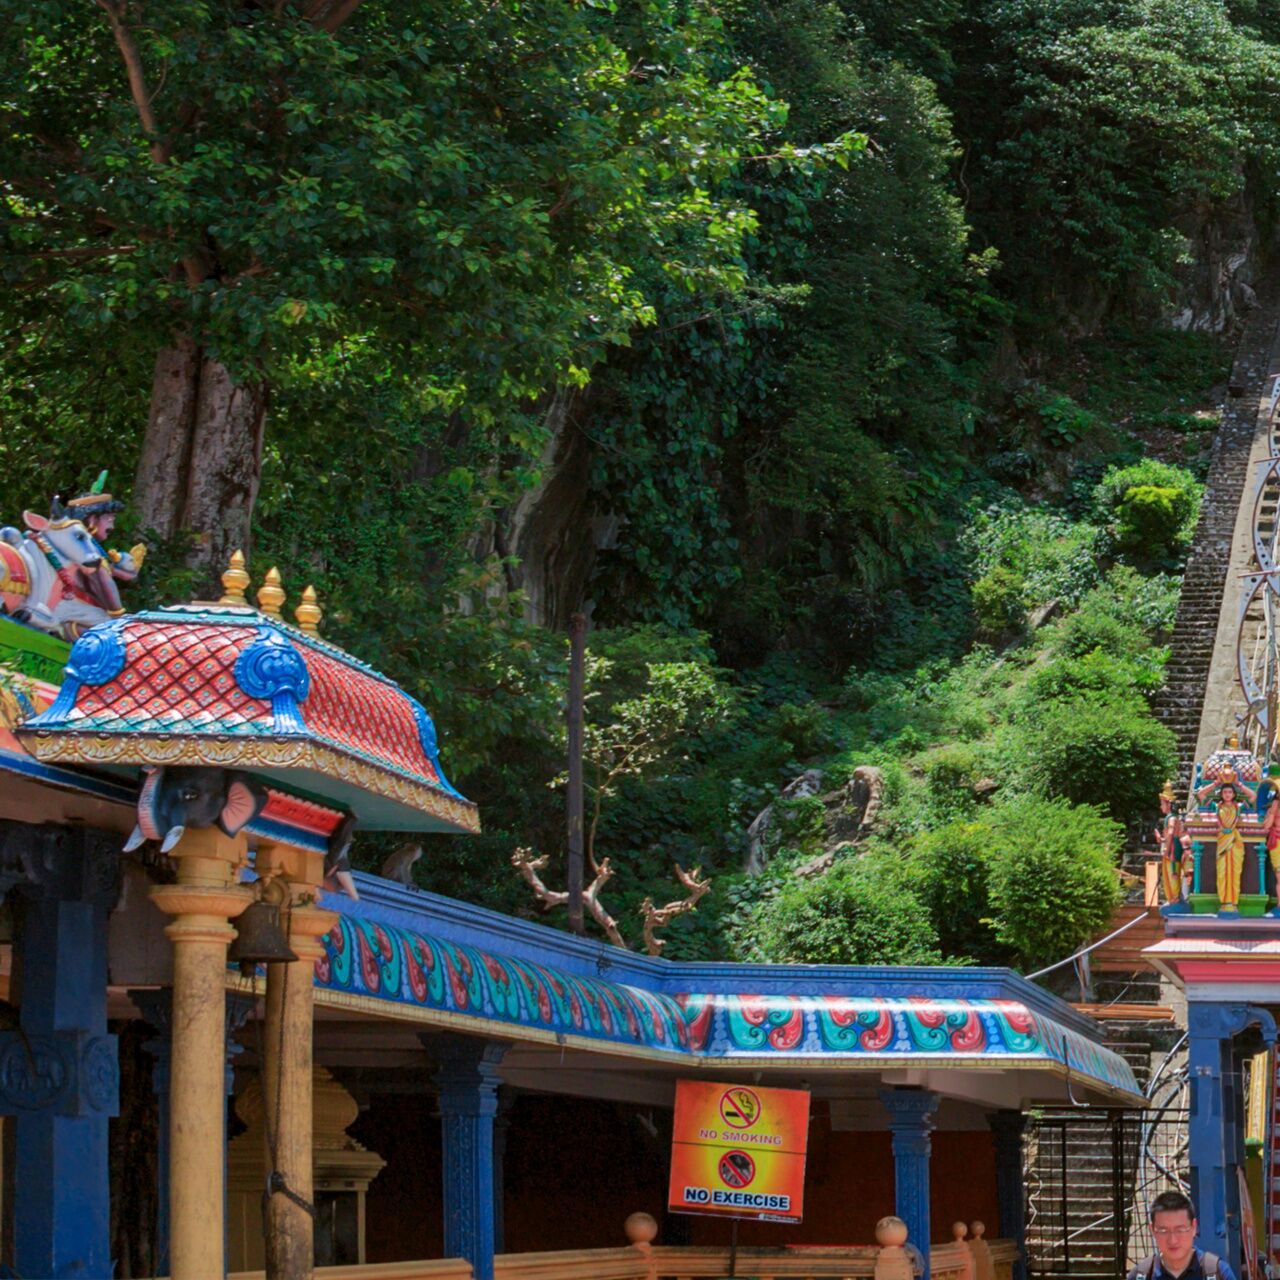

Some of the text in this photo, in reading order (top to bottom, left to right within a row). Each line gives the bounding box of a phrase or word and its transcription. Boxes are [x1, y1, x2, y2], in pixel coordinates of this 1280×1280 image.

[699, 1129, 782, 1145] NO SMOKING
[685, 1187, 789, 1209] NO EXERCISE
